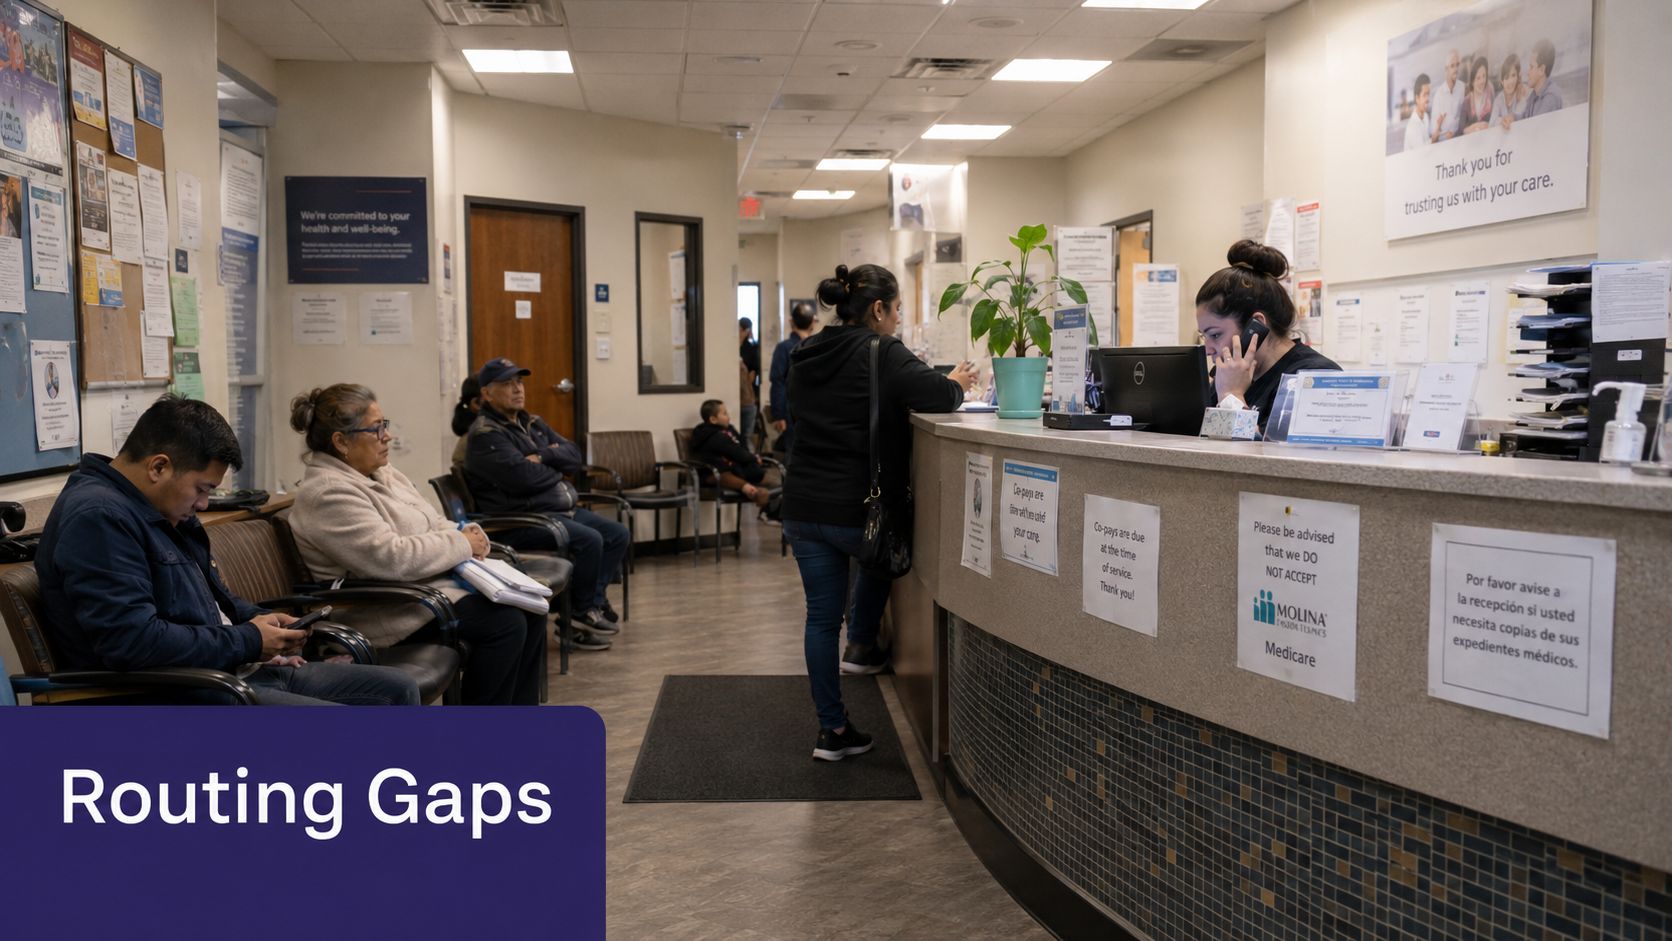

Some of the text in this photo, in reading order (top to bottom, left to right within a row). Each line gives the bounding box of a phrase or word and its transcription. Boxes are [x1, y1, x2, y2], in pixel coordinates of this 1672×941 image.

[1435, 149, 1513, 180] Thank you for
[1405, 172, 1554, 214] trusting us with your care.
[301, 211, 410, 222] We're committed to your
[301, 225, 400, 235] health and well-being.
[1094, 522, 1145, 543] Co-pays are due
[1254, 521, 1335, 544] Please be advised
[1100, 544, 1136, 560] at the time
[1265, 545, 1318, 564] that we DO
[1102, 563, 1133, 579] of service.
[1266, 566, 1317, 585] NOT ACCEPT
[1100, 581, 1134, 600] Thank you!
[1466, 573, 1560, 597] Por favor avise a
[1277, 603, 1327, 627] MOLINA
[1457, 593, 1575, 623] la recepción si usted
[1453, 615, 1579, 646] necesita copias de sus
[1265, 641, 1316, 667] Medicare
[1453, 636, 1578, 669] expedientes médicos.
